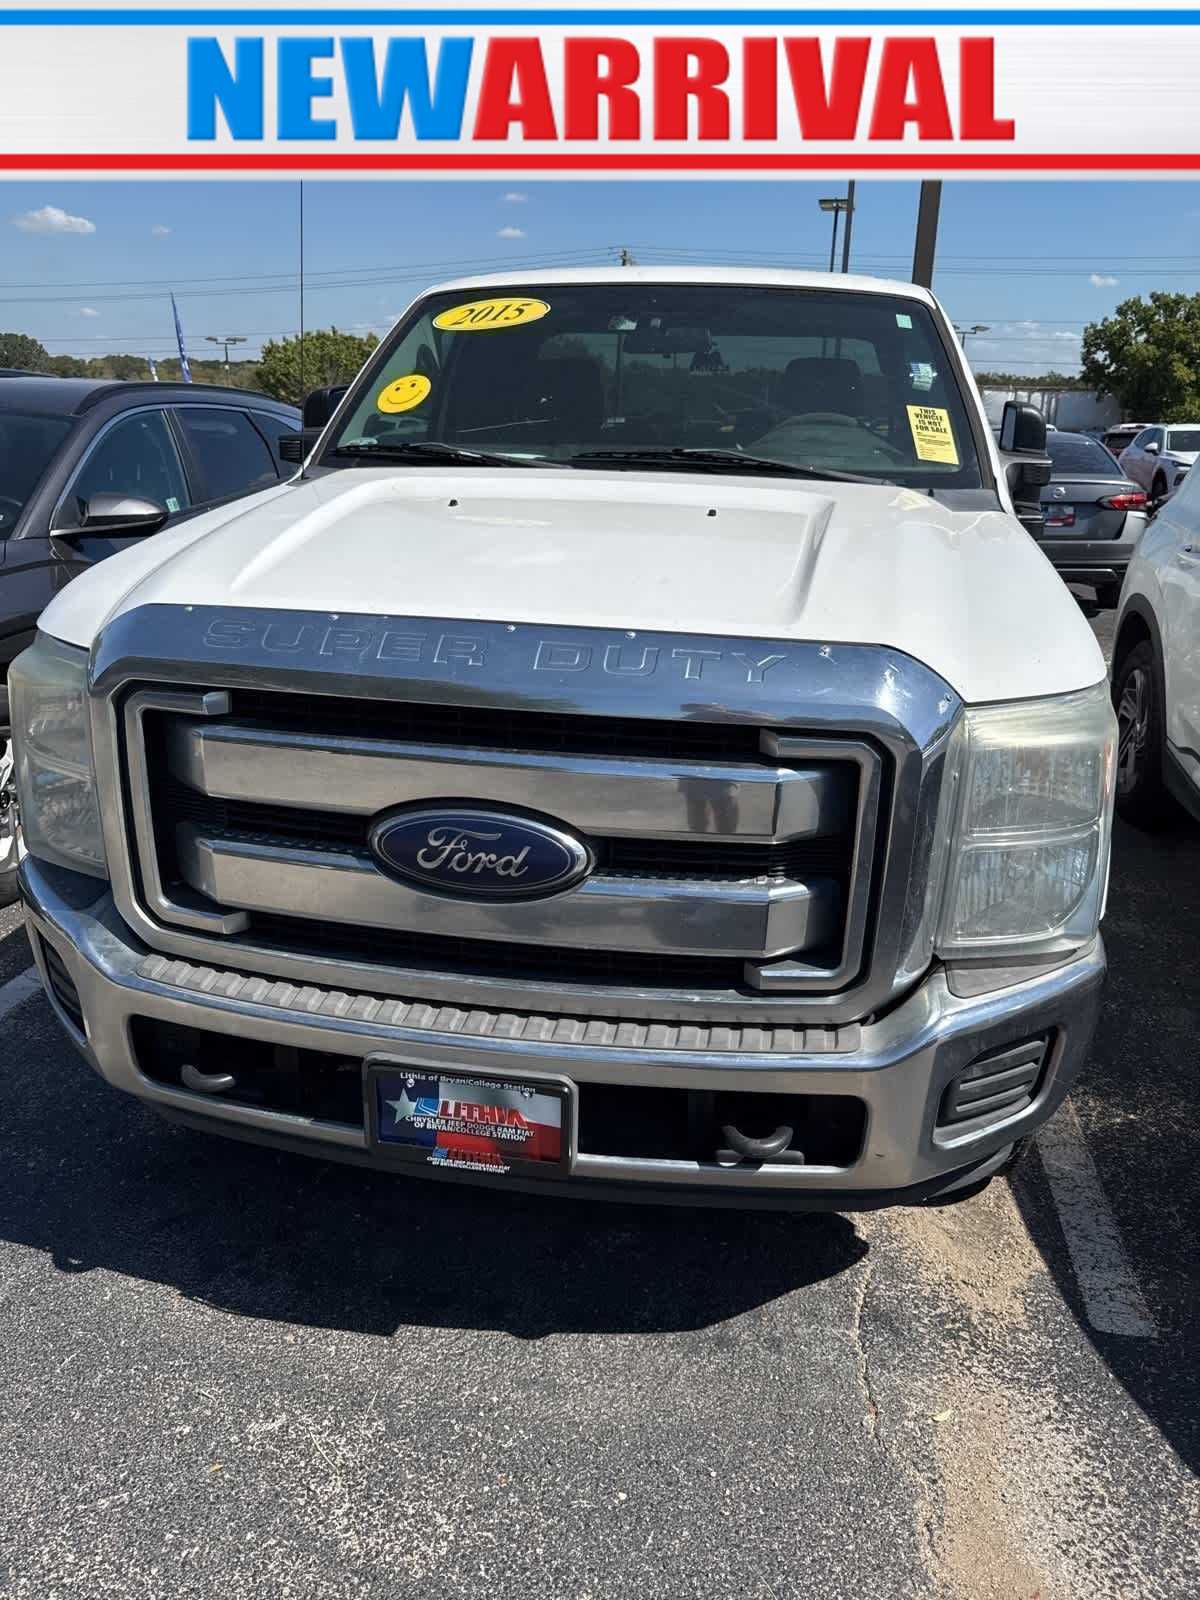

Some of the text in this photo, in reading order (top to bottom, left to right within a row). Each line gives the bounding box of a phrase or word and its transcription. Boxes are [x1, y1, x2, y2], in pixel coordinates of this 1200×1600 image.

[450, 302, 533, 326] 2015
[914, 412, 943, 421] VEHICLE
[919, 408, 936, 416] THIS
[202, 619, 788, 687] SUPER DUTY
[416, 826, 531, 878] Ford
[400, 1072, 426, 1081] Lithia
[440, 1075, 502, 1089] Bryan/College
[503, 1083, 537, 1094] Station
[438, 1098, 529, 1129] LITHIA
[405, 1115, 536, 1137] CHRYSLER JEEP DODGE RAM FIAT
[426, 1122, 491, 1137] BRYAN/COLLEGE
[492, 1131, 526, 1141] STATION
